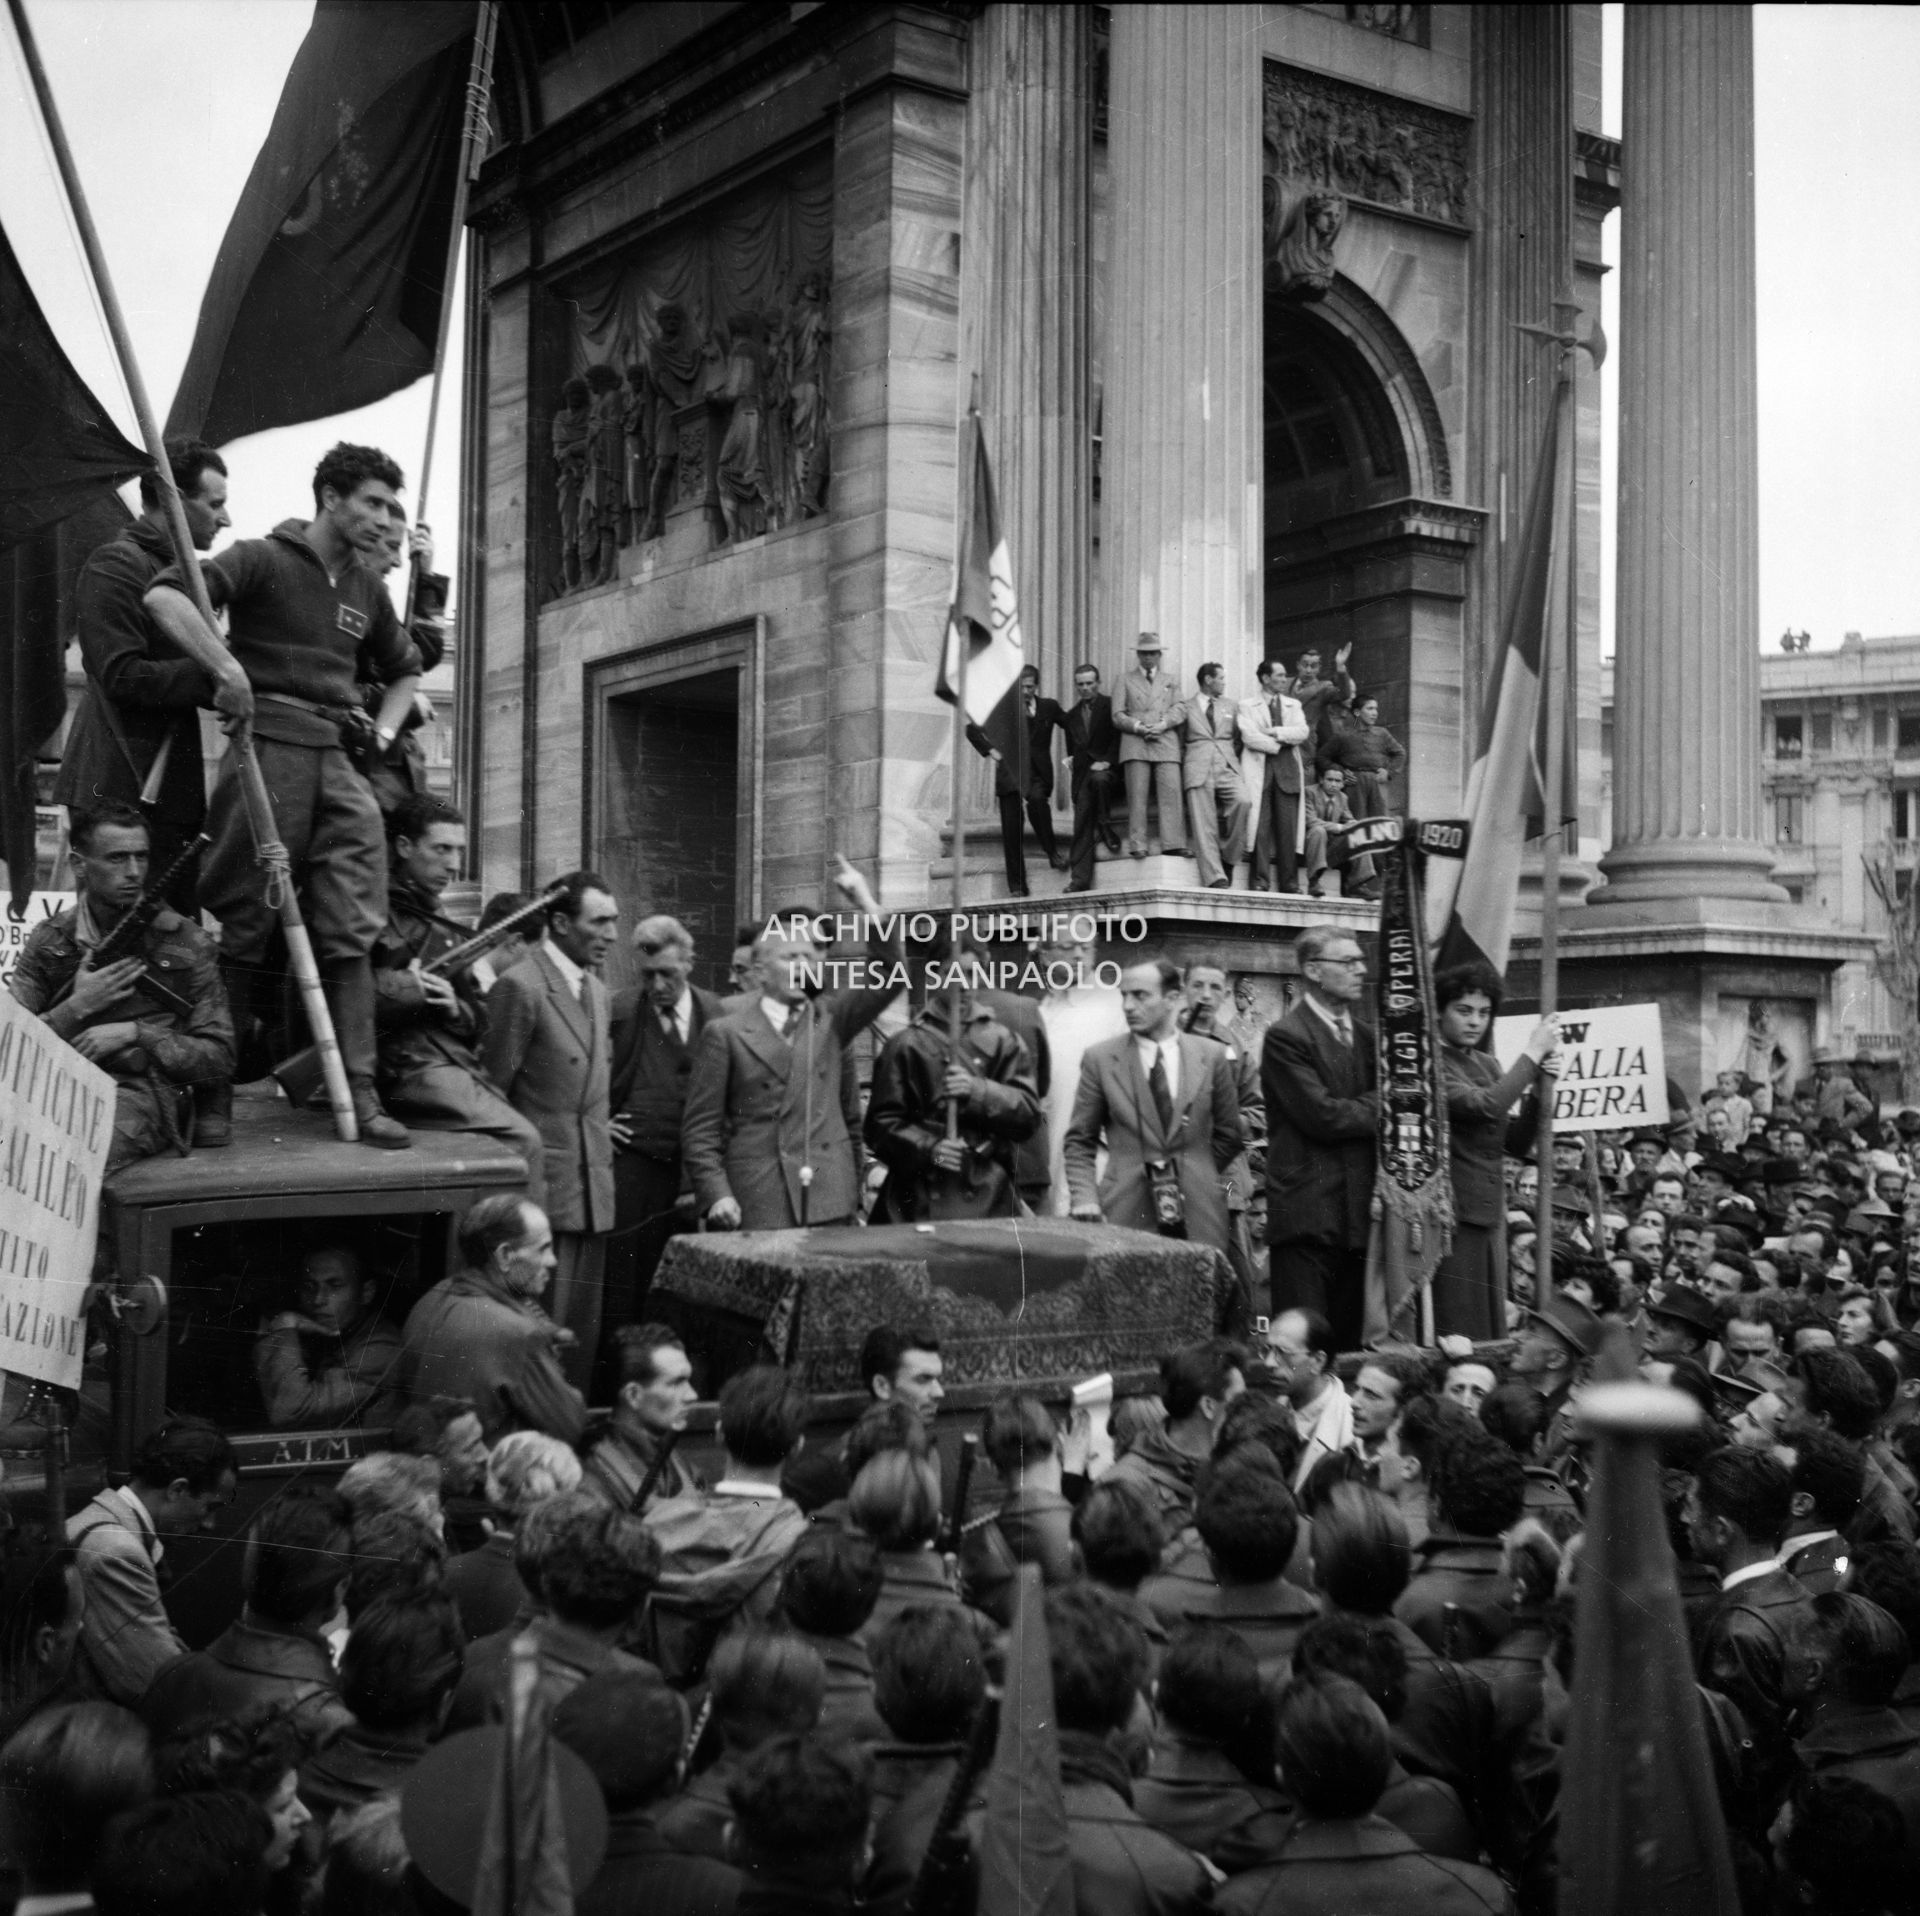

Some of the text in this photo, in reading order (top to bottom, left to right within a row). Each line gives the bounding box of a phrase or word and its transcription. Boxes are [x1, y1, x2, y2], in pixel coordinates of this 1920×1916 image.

[1420, 822, 1463, 849] 1920
[1388, 929, 1422, 1093] LEGA OPERAI
[1559, 1022, 1591, 1044] W
[1562, 1046, 1648, 1081] ALIA
[0, 1125, 87, 1229] ALILEO
